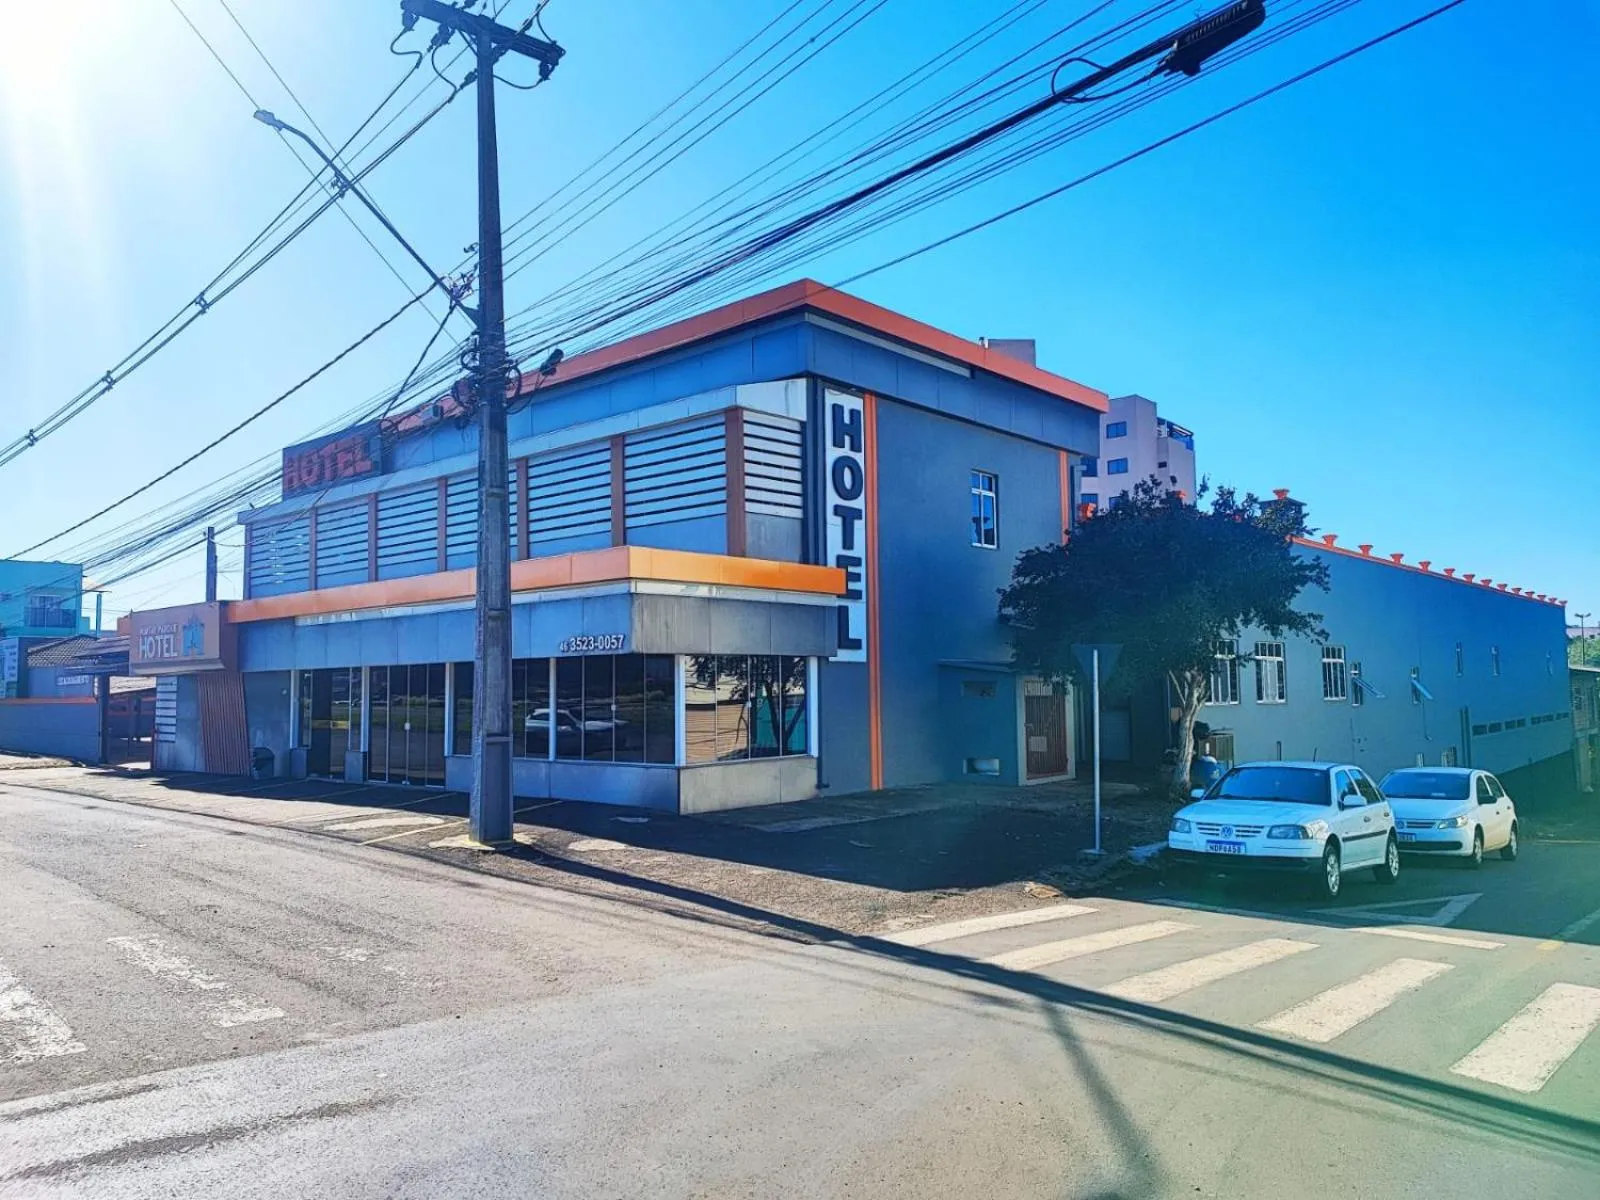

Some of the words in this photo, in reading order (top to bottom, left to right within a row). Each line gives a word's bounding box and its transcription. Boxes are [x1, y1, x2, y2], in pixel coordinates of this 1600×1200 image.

[284, 434, 373, 489] HOTEL
[831, 403, 863, 650] HOTEL
[139, 634, 178, 659] HOTEL
[570, 634, 625, 651] 3523-0057
